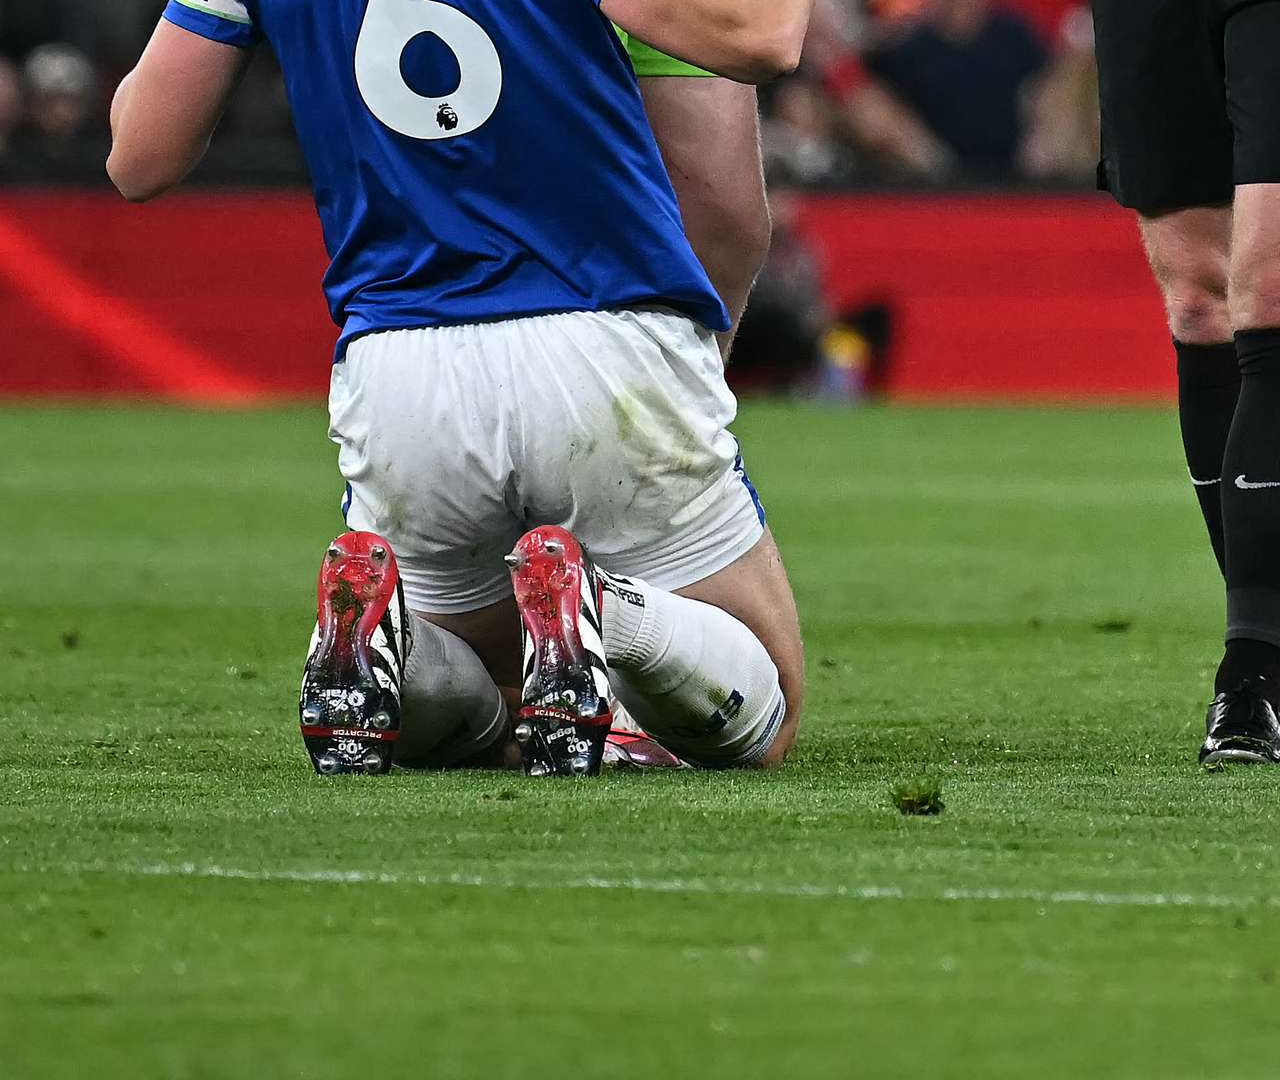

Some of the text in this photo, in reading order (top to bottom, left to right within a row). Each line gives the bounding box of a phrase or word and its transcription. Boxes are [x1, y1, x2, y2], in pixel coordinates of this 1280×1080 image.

[534, 709, 577, 723] PREDATOR
[332, 729, 383, 739] PREDATOR
[546, 726, 576, 745] legal
